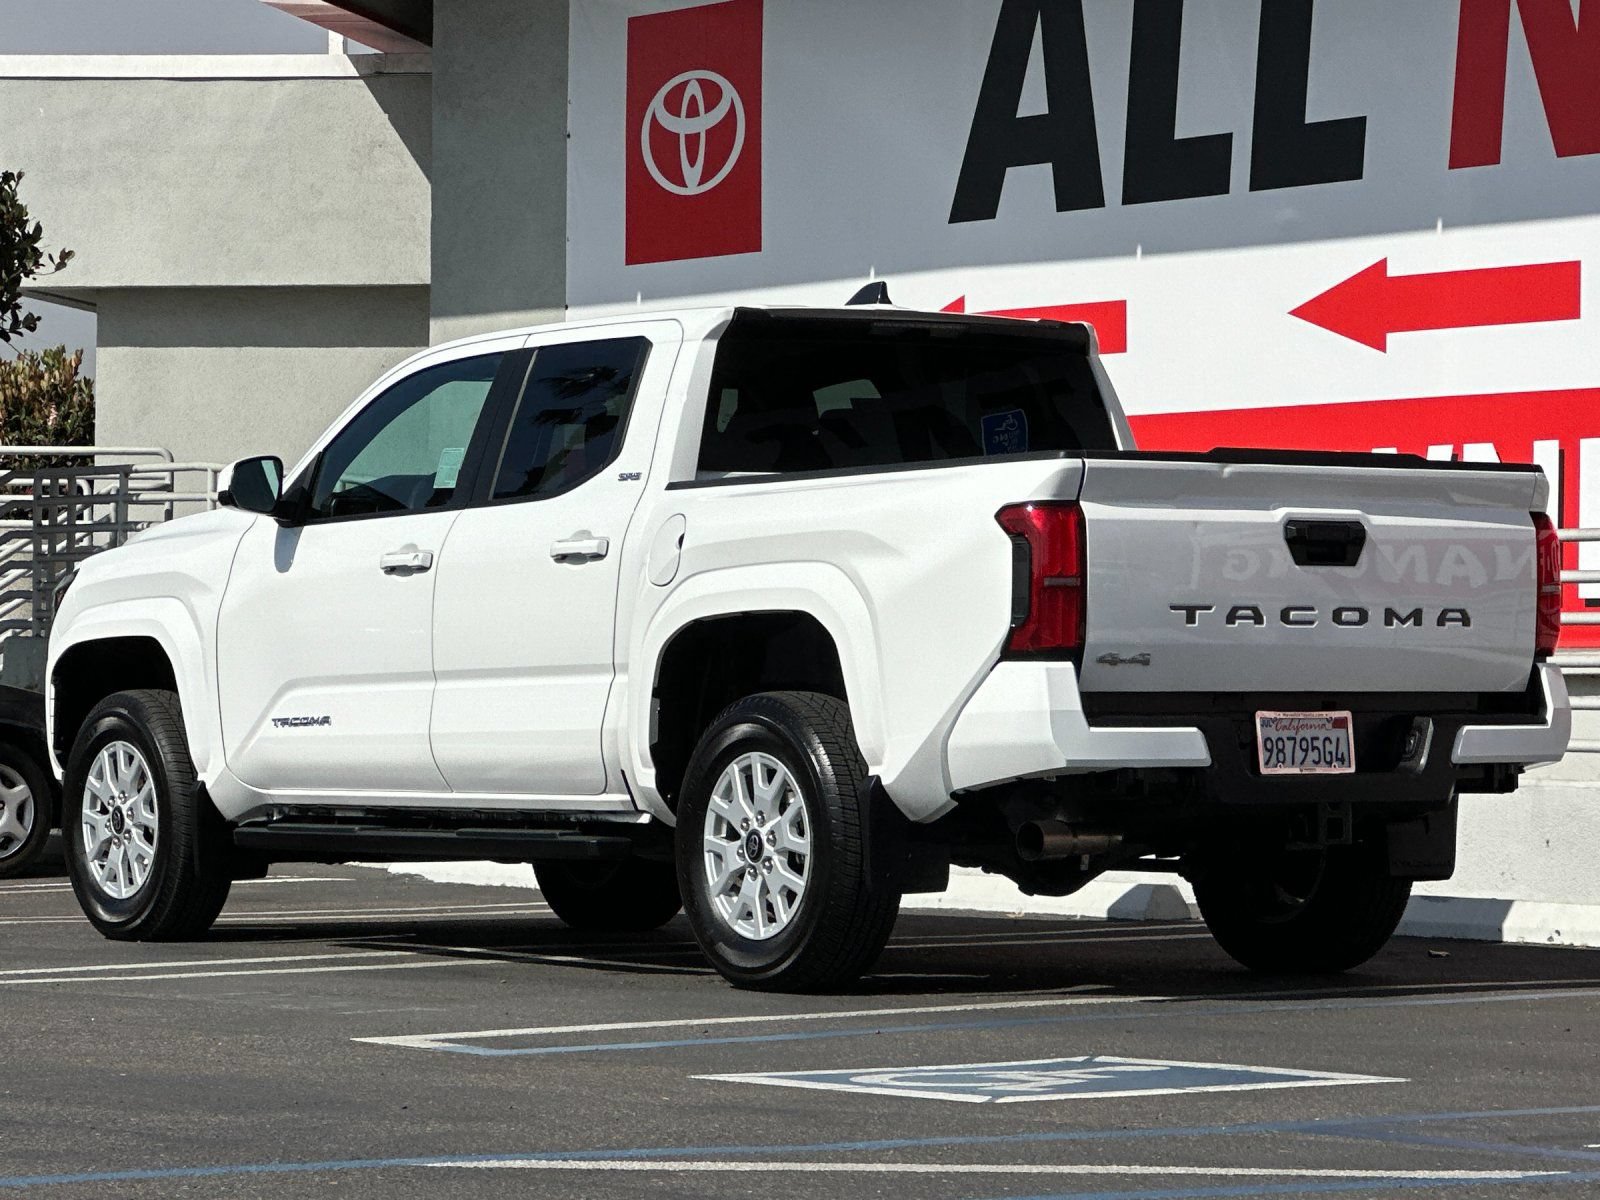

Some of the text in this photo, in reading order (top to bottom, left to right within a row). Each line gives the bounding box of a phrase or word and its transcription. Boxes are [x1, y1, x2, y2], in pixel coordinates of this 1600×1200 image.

[949, 0, 1366, 224] ALL
[1169, 604, 1472, 628] TACOMA
[272, 715, 331, 728] TACOMA
[1275, 718, 1329, 735] California
[1263, 736, 1346, 766] 98795G4
